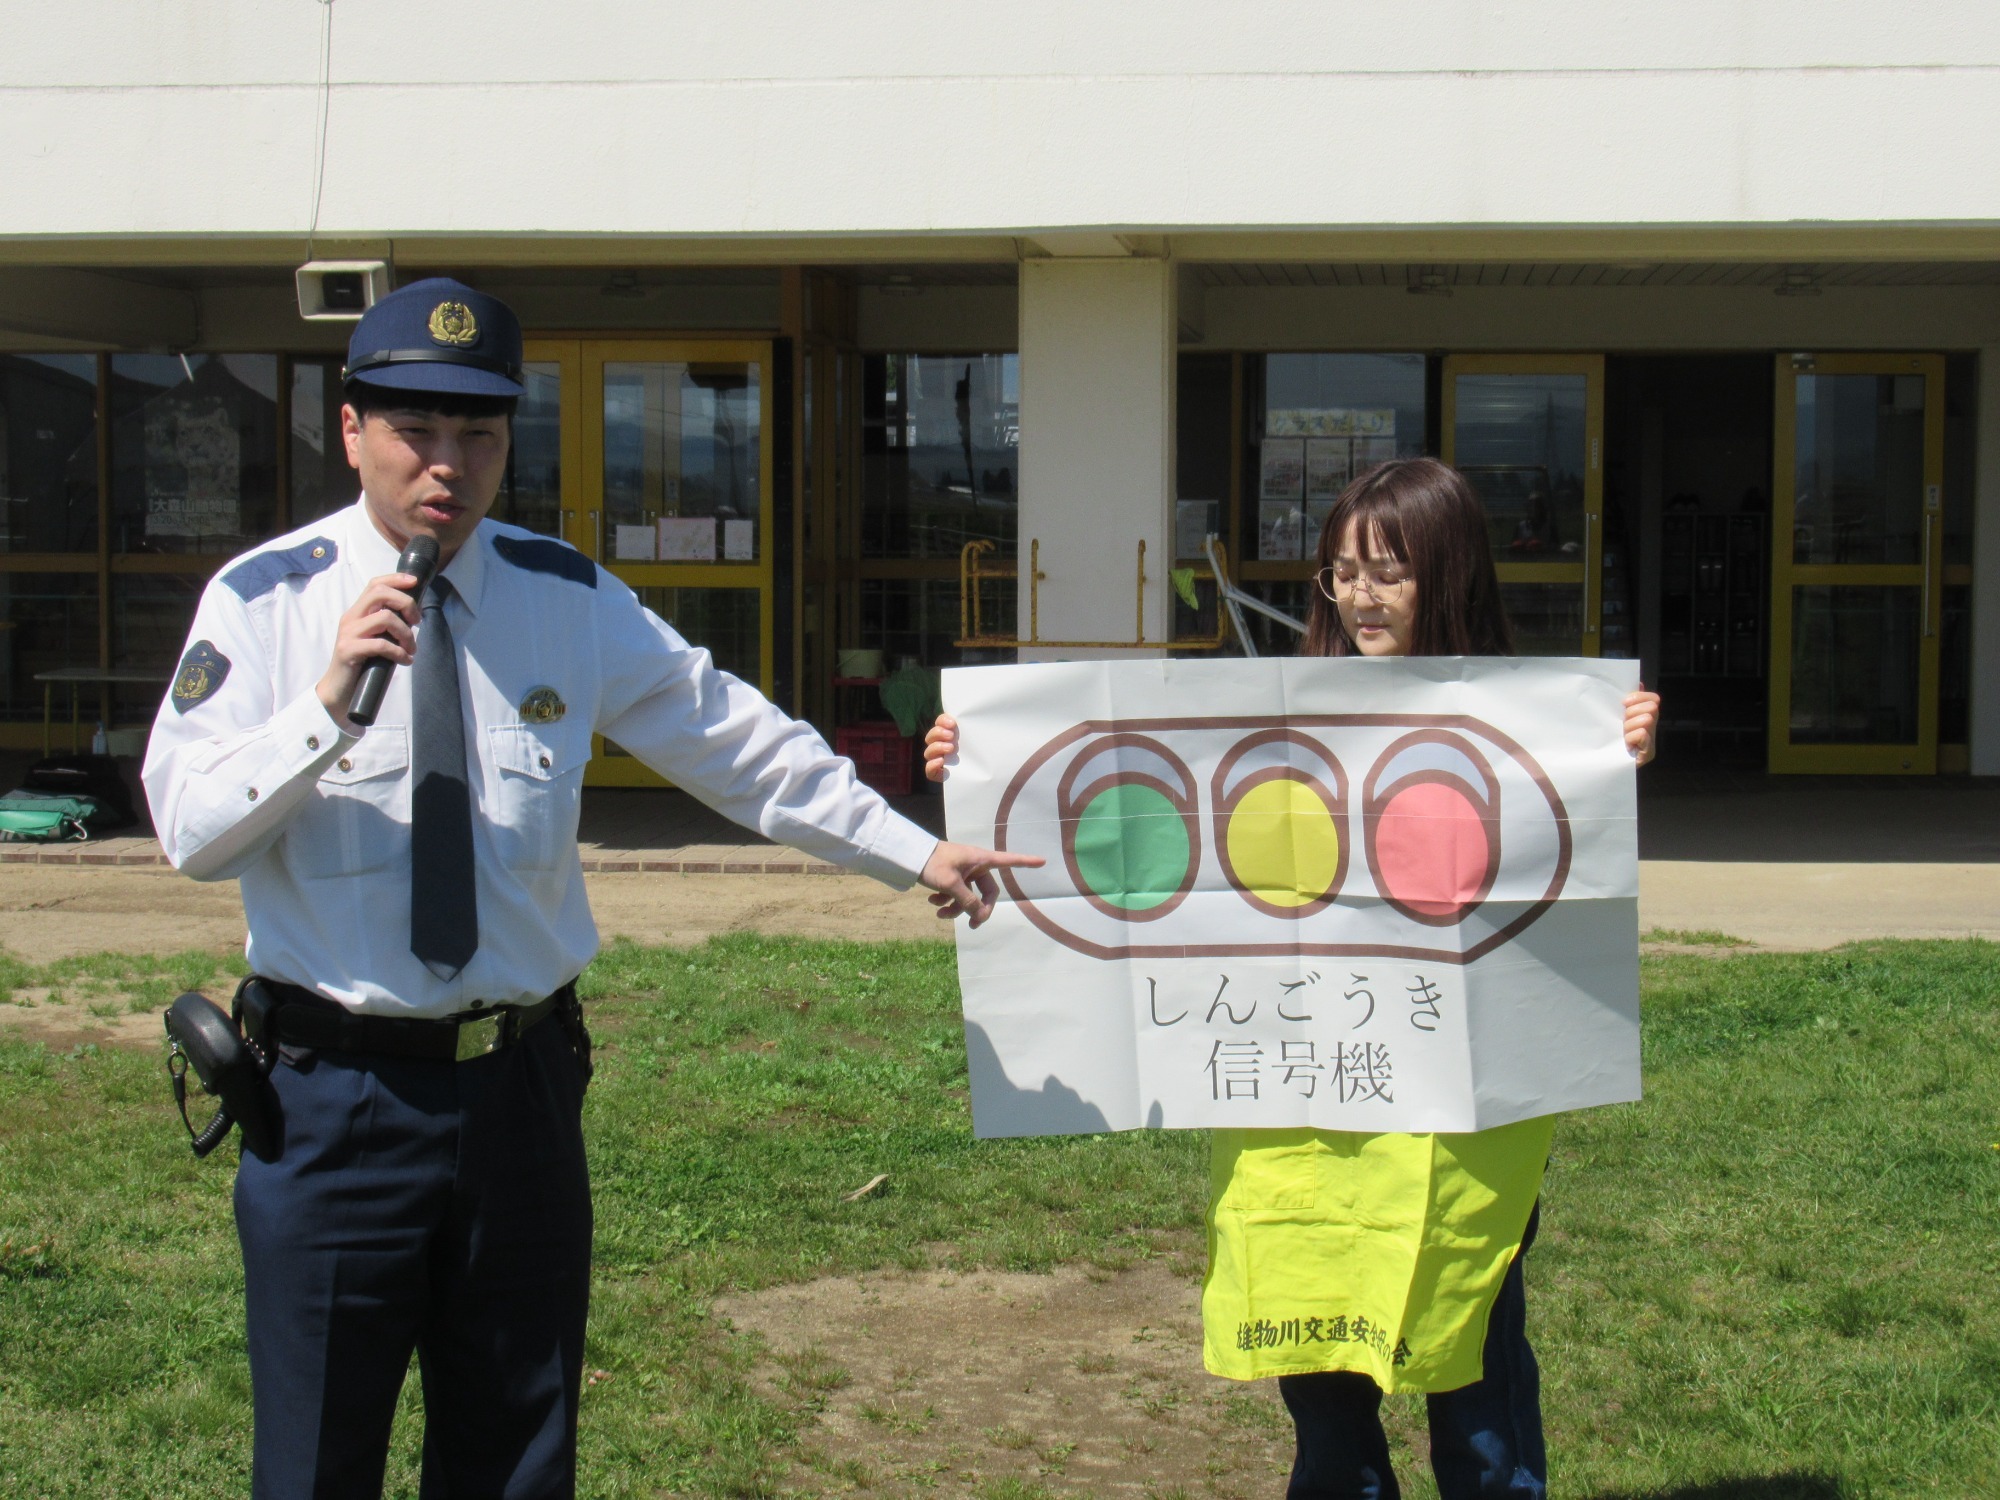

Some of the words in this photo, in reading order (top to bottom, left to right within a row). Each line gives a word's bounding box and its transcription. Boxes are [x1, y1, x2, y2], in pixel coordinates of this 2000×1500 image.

[1146, 971, 1443, 1032] しんごうき
[1203, 1039, 1395, 1104] 信号機
